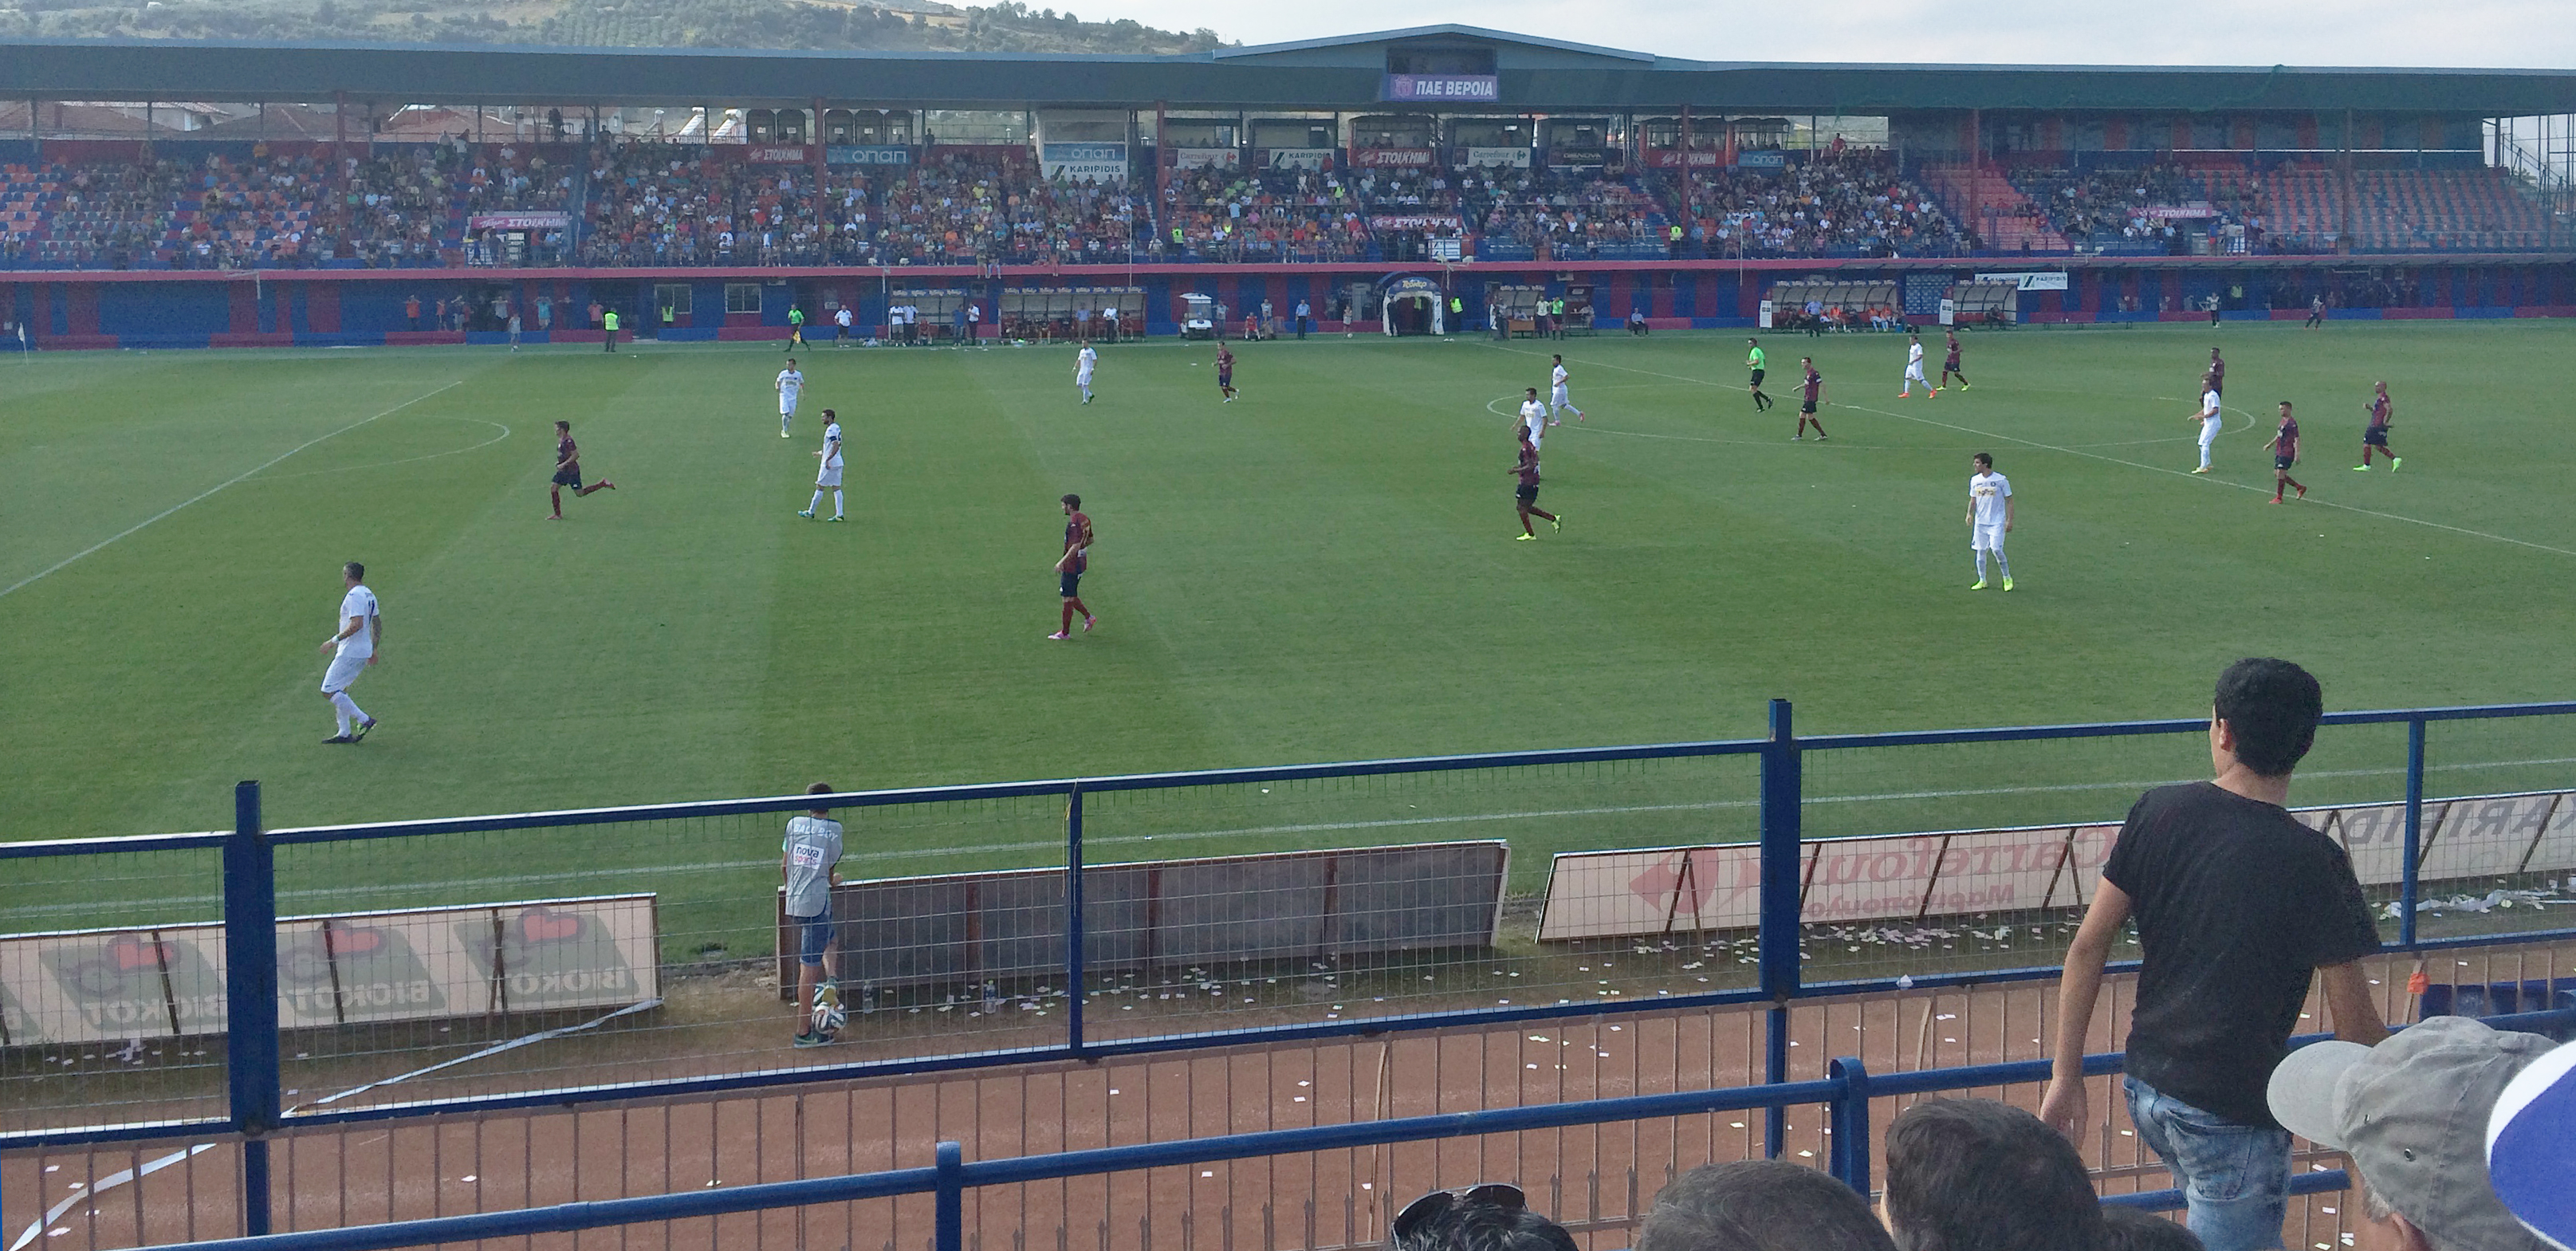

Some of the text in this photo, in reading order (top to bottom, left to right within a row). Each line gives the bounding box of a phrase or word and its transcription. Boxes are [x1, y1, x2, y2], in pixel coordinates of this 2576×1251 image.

[1416, 81, 1493, 96] ΠΑΕ ΒΕΡΟΙΑ
[793, 824, 839, 842] BALL BOY
[796, 845, 820, 857] nova
[795, 854, 817, 864] sports
